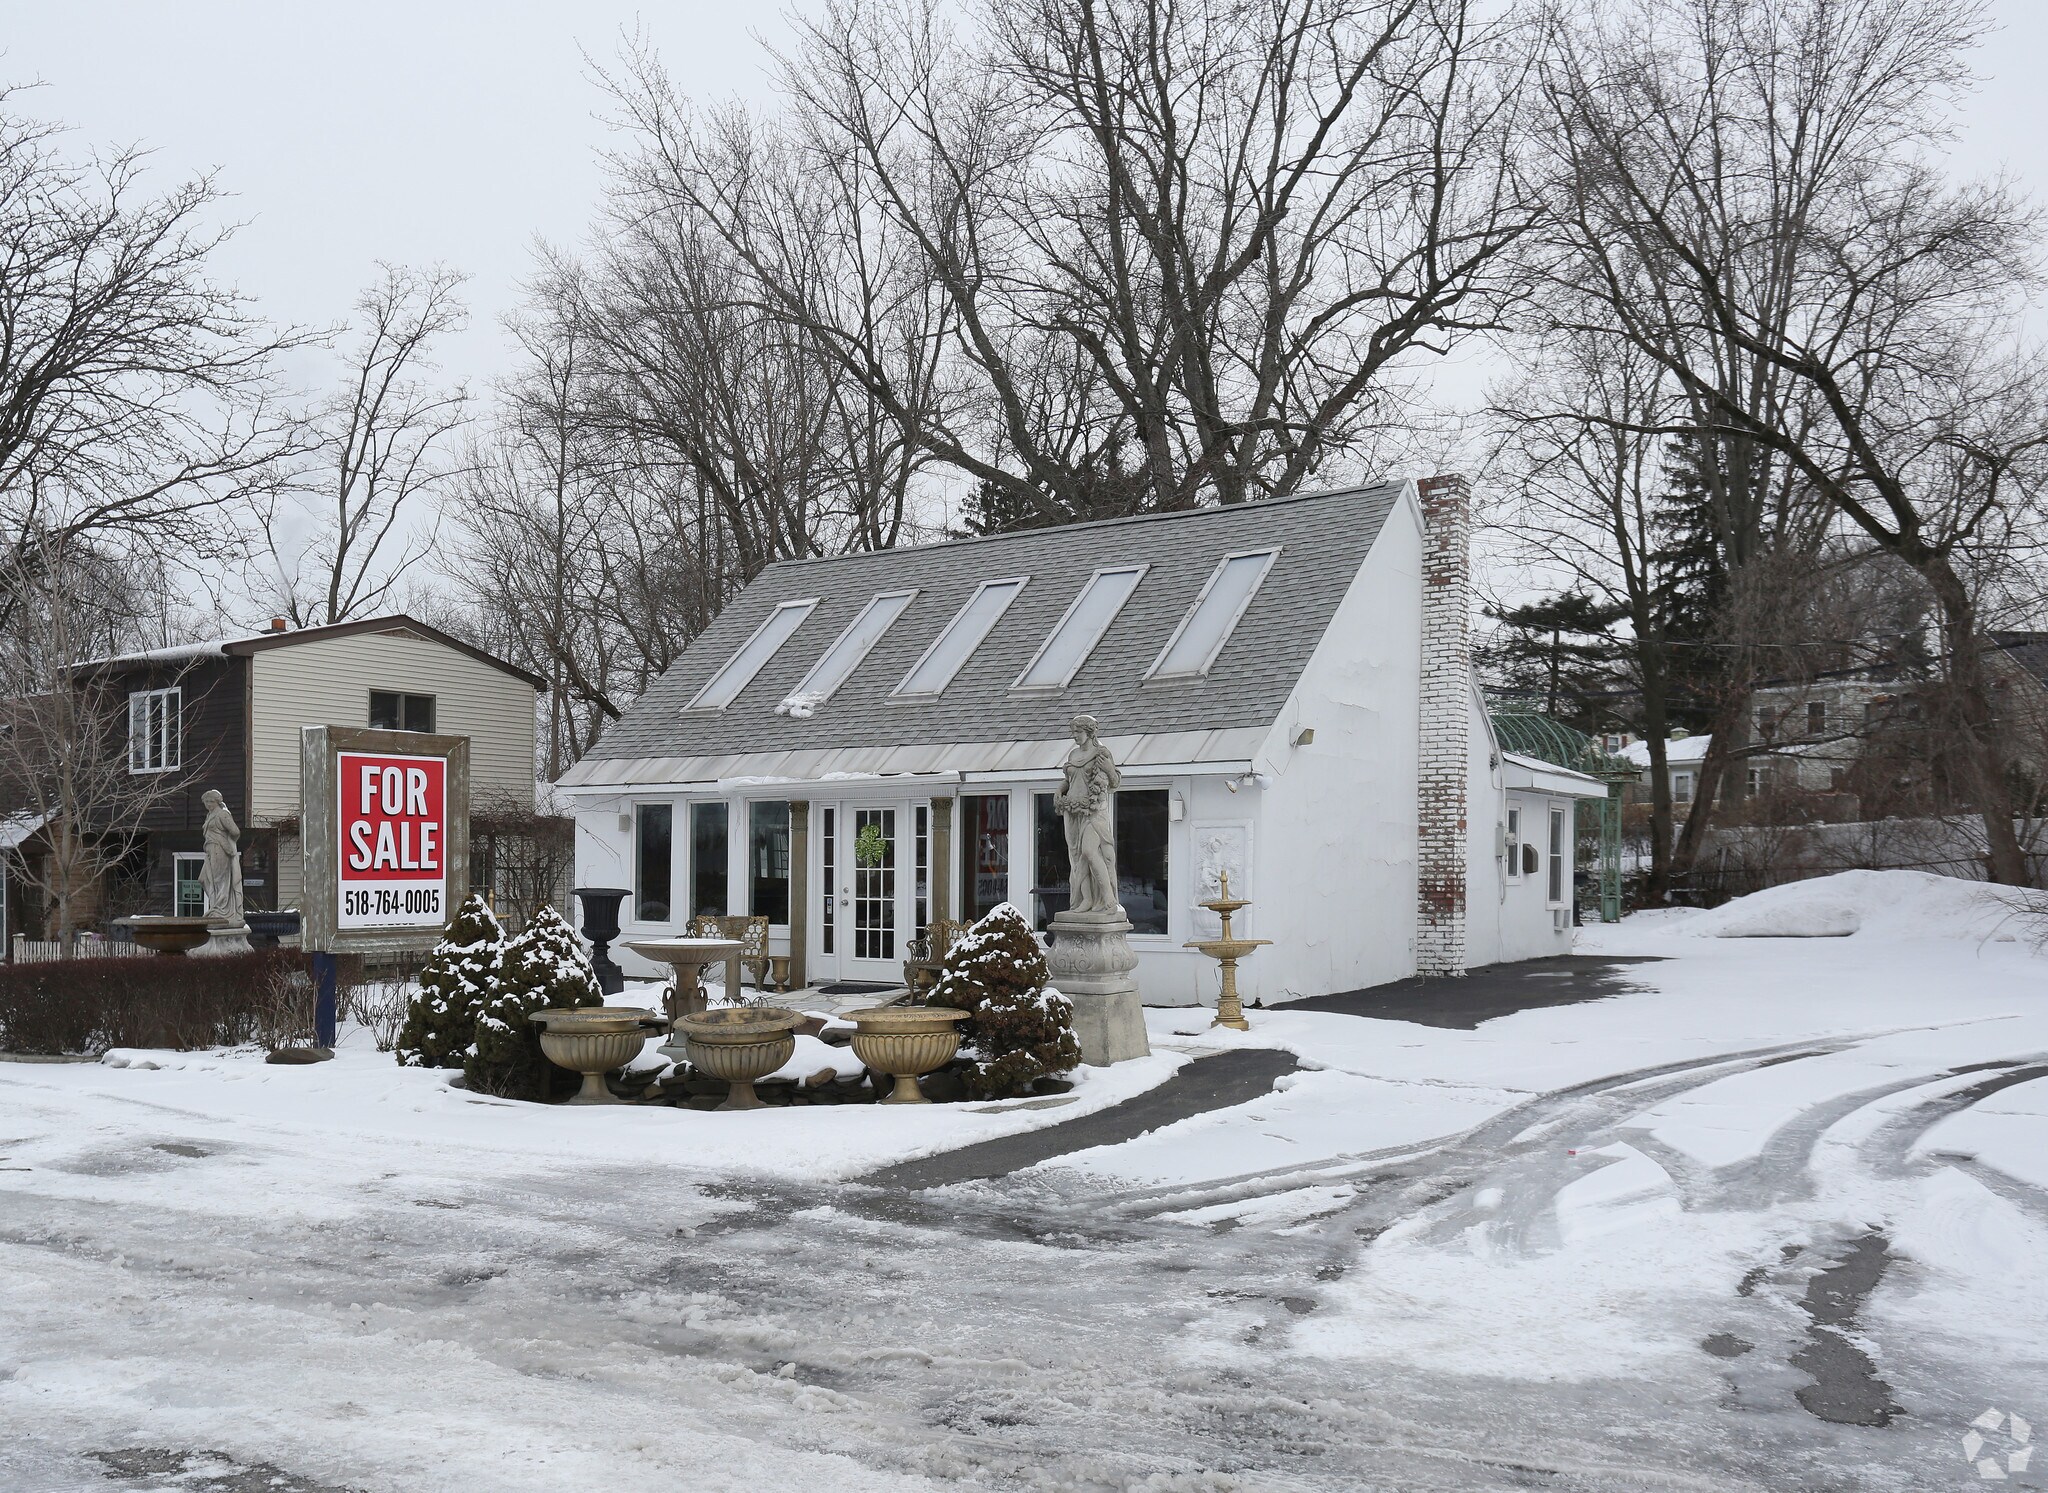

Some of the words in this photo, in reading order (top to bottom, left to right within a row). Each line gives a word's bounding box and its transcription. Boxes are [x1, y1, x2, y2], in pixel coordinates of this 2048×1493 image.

[361, 766, 429, 816] FOR
[349, 820, 439, 871] SALE
[345, 889, 440, 917] 518-764-0005
